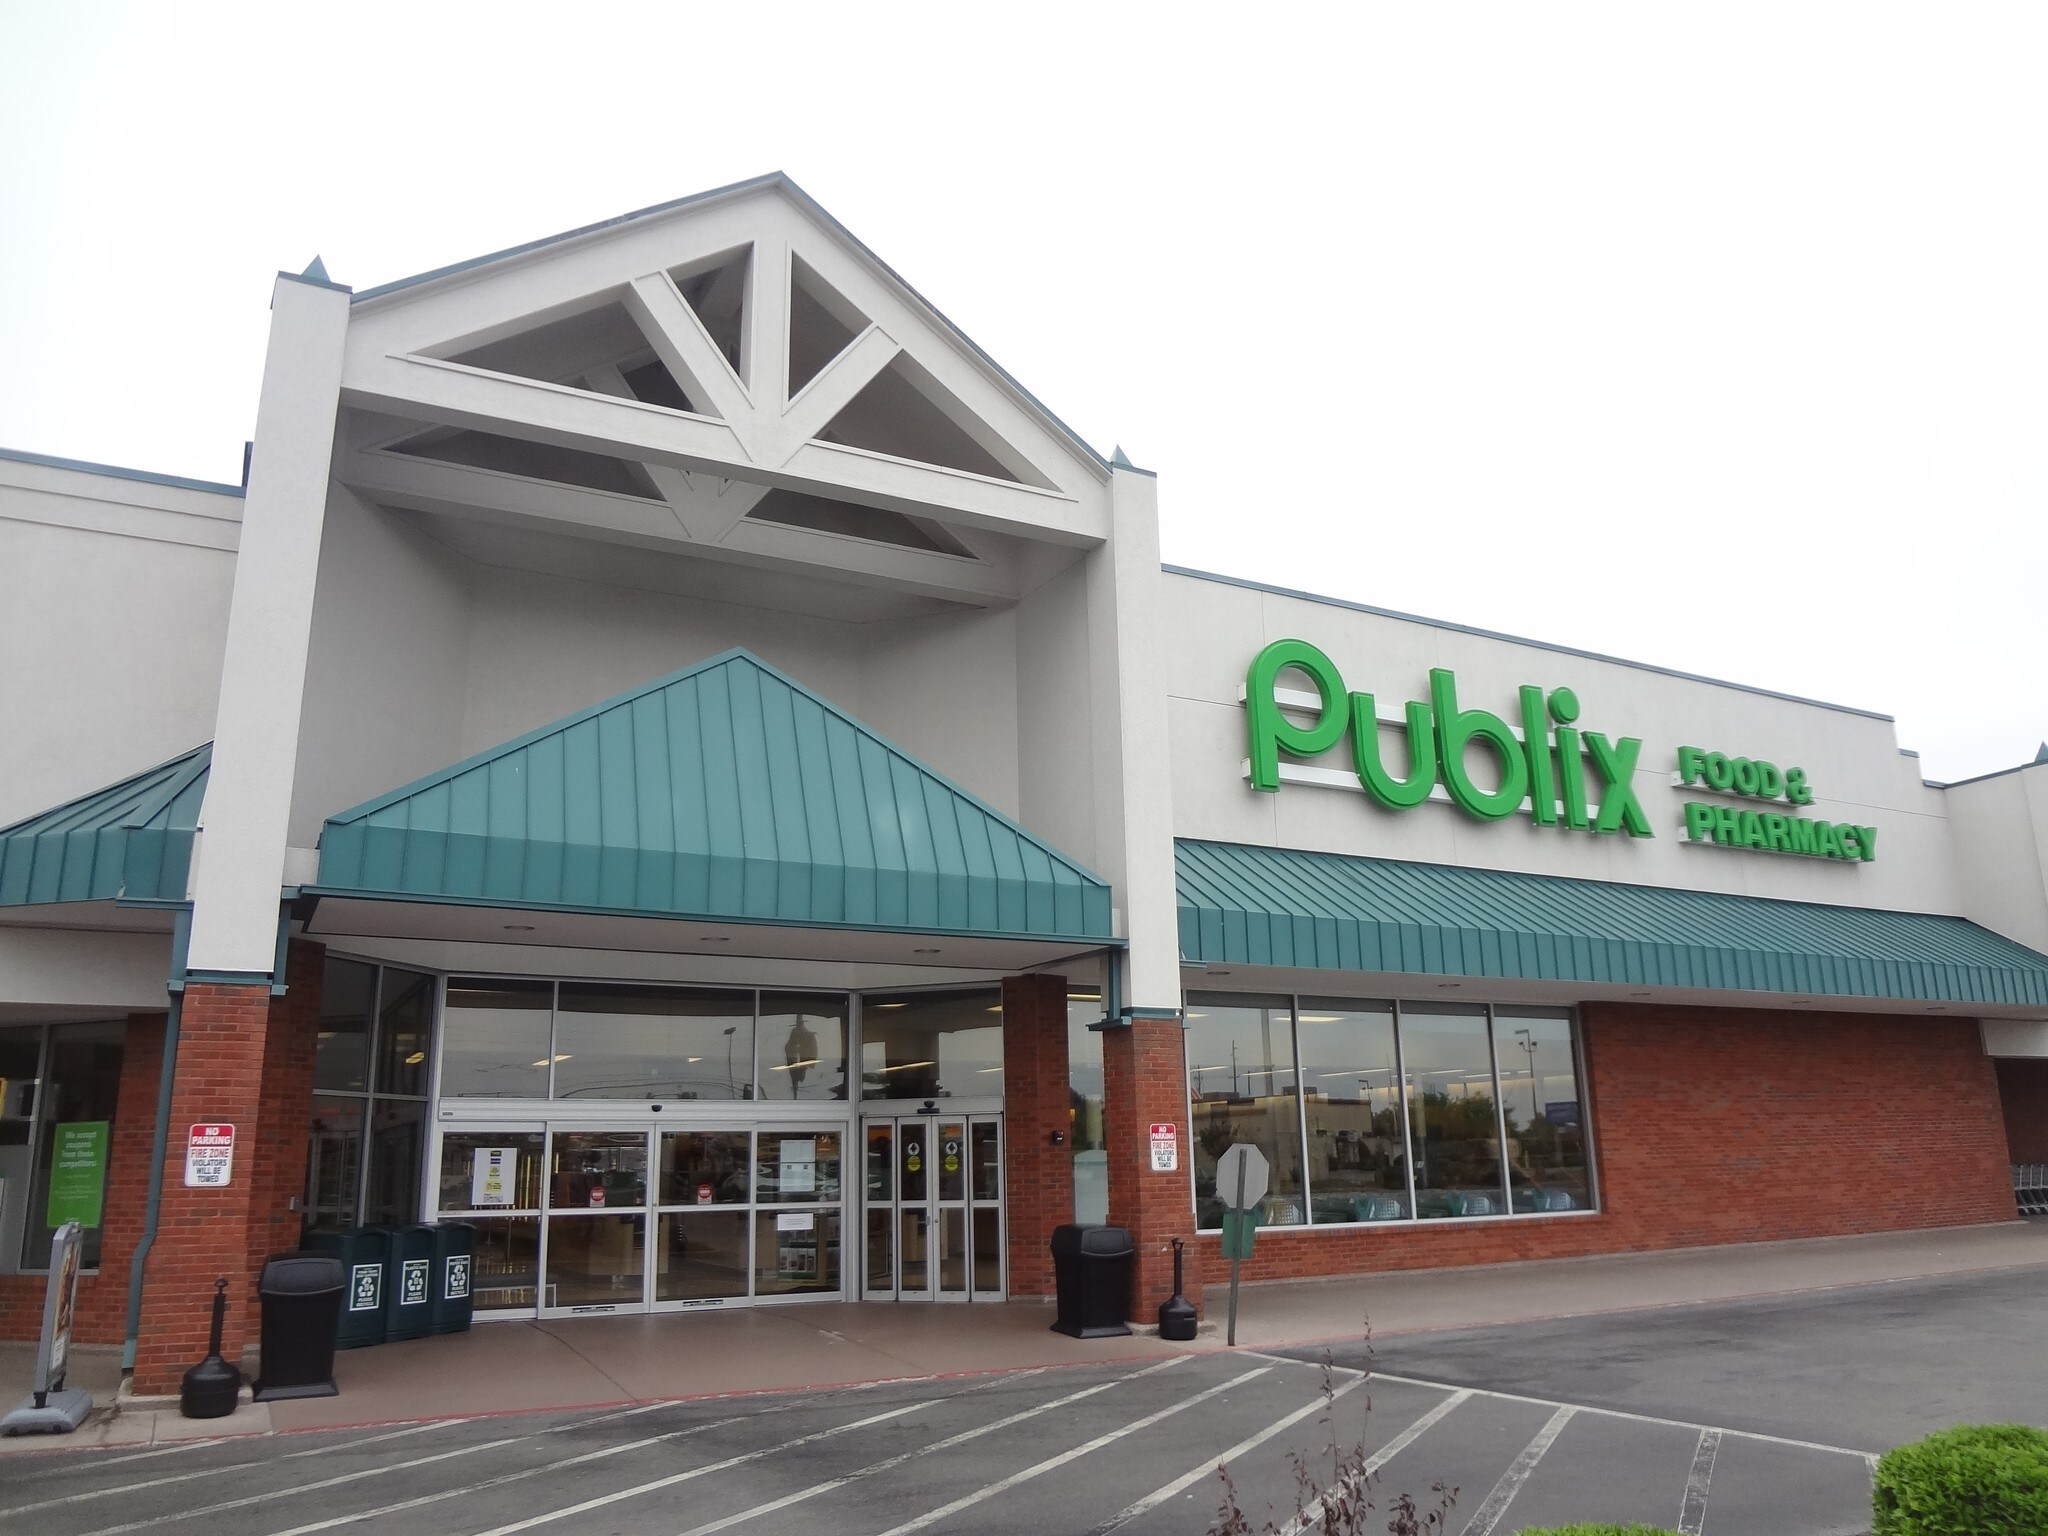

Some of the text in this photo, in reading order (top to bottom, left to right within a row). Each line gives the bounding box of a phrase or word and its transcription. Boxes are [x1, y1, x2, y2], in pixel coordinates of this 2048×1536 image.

[1246, 638, 1655, 839] Publix
[1678, 745, 1813, 804] FOOD &
[1683, 801, 1878, 862] PHARMACY
[205, 1126, 219, 1136] NO
[191, 1135, 231, 1145] PARKING
[191, 1148, 229, 1158] FIRE ZONE
[192, 1159, 227, 1167] VIOLATORS
[196, 1166, 222, 1175] WILL BE
[197, 1175, 219, 1183] TOWED
